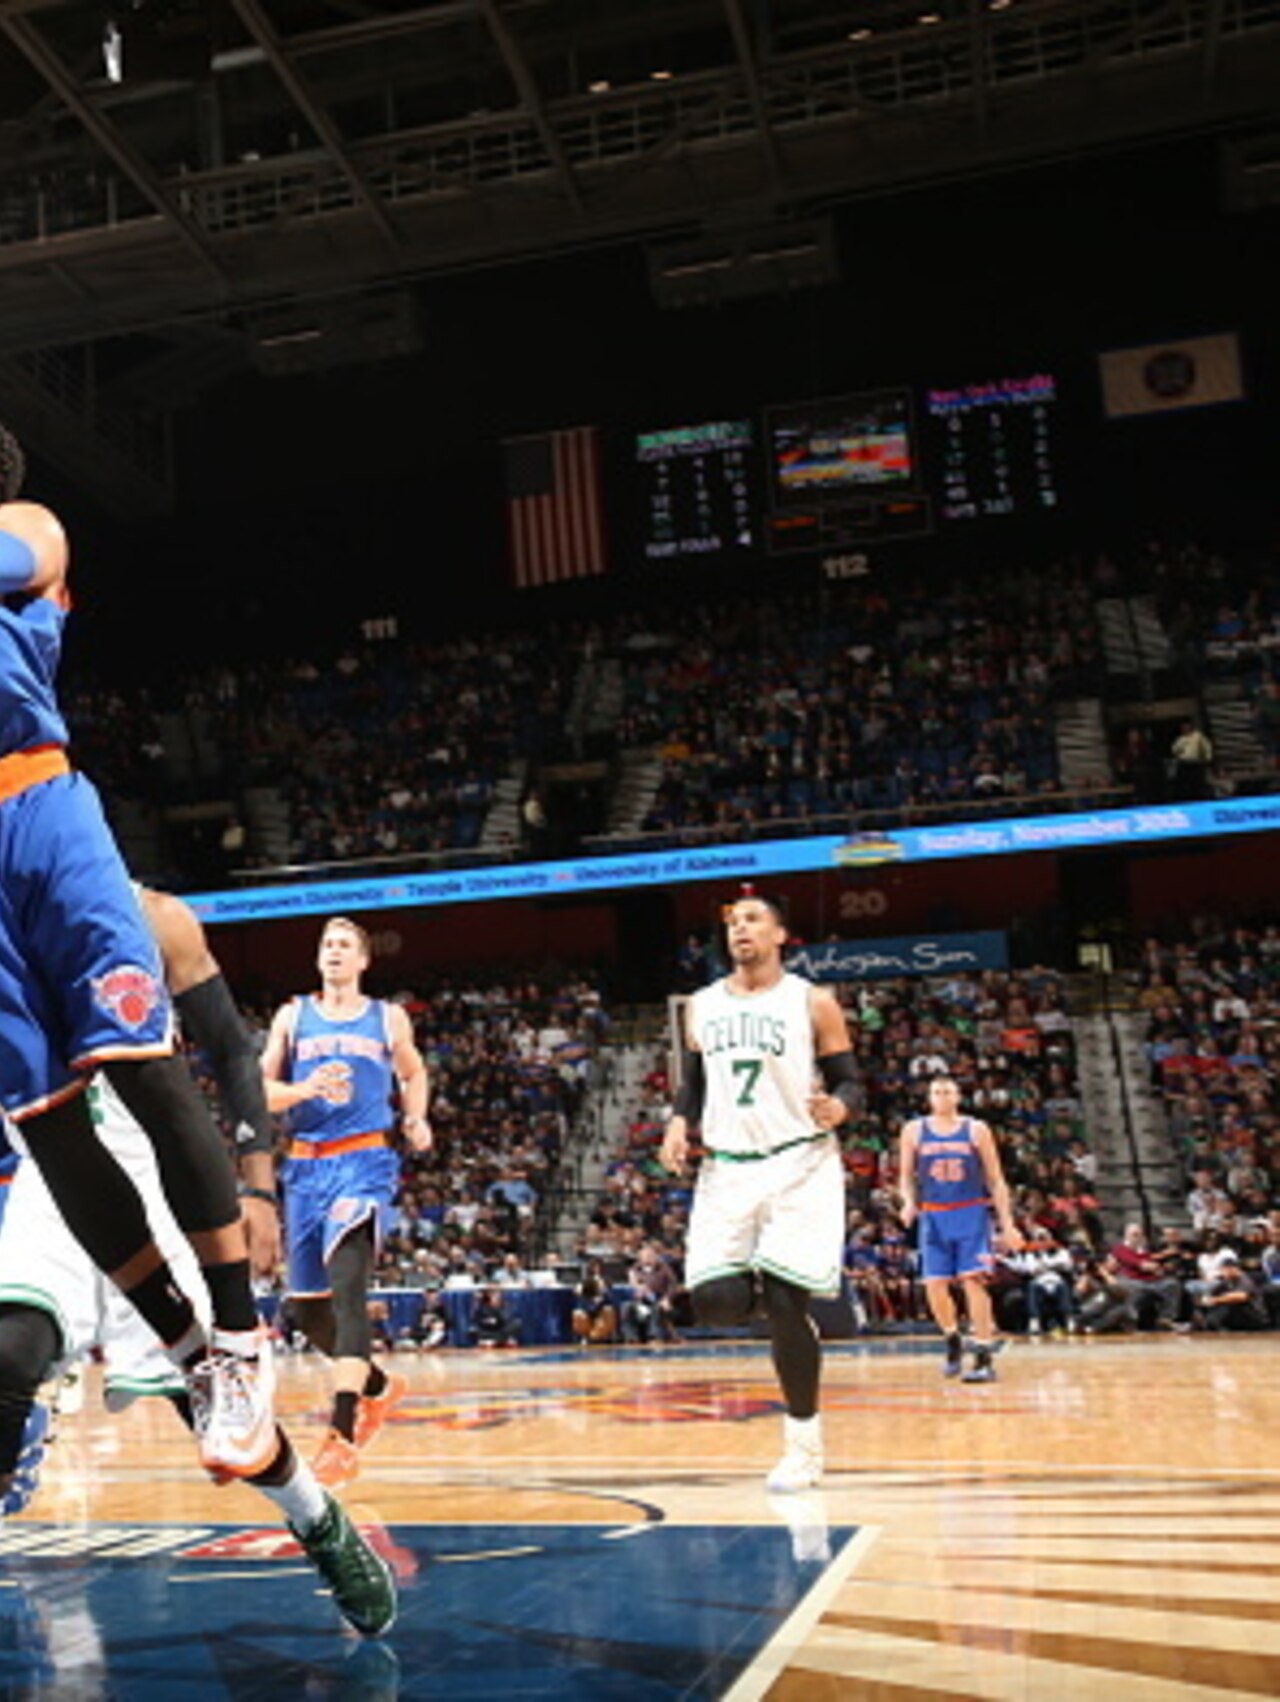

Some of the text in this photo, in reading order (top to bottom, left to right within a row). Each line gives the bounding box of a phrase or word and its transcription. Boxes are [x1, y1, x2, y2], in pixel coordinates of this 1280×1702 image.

[823, 555, 869, 579] 112
[407, 880, 462, 898] Temple
[839, 891, 888, 918] 20
[911, 942, 977, 971] Sun
[704, 1011, 785, 1057] CELTICS
[732, 1058, 763, 1108] 7
